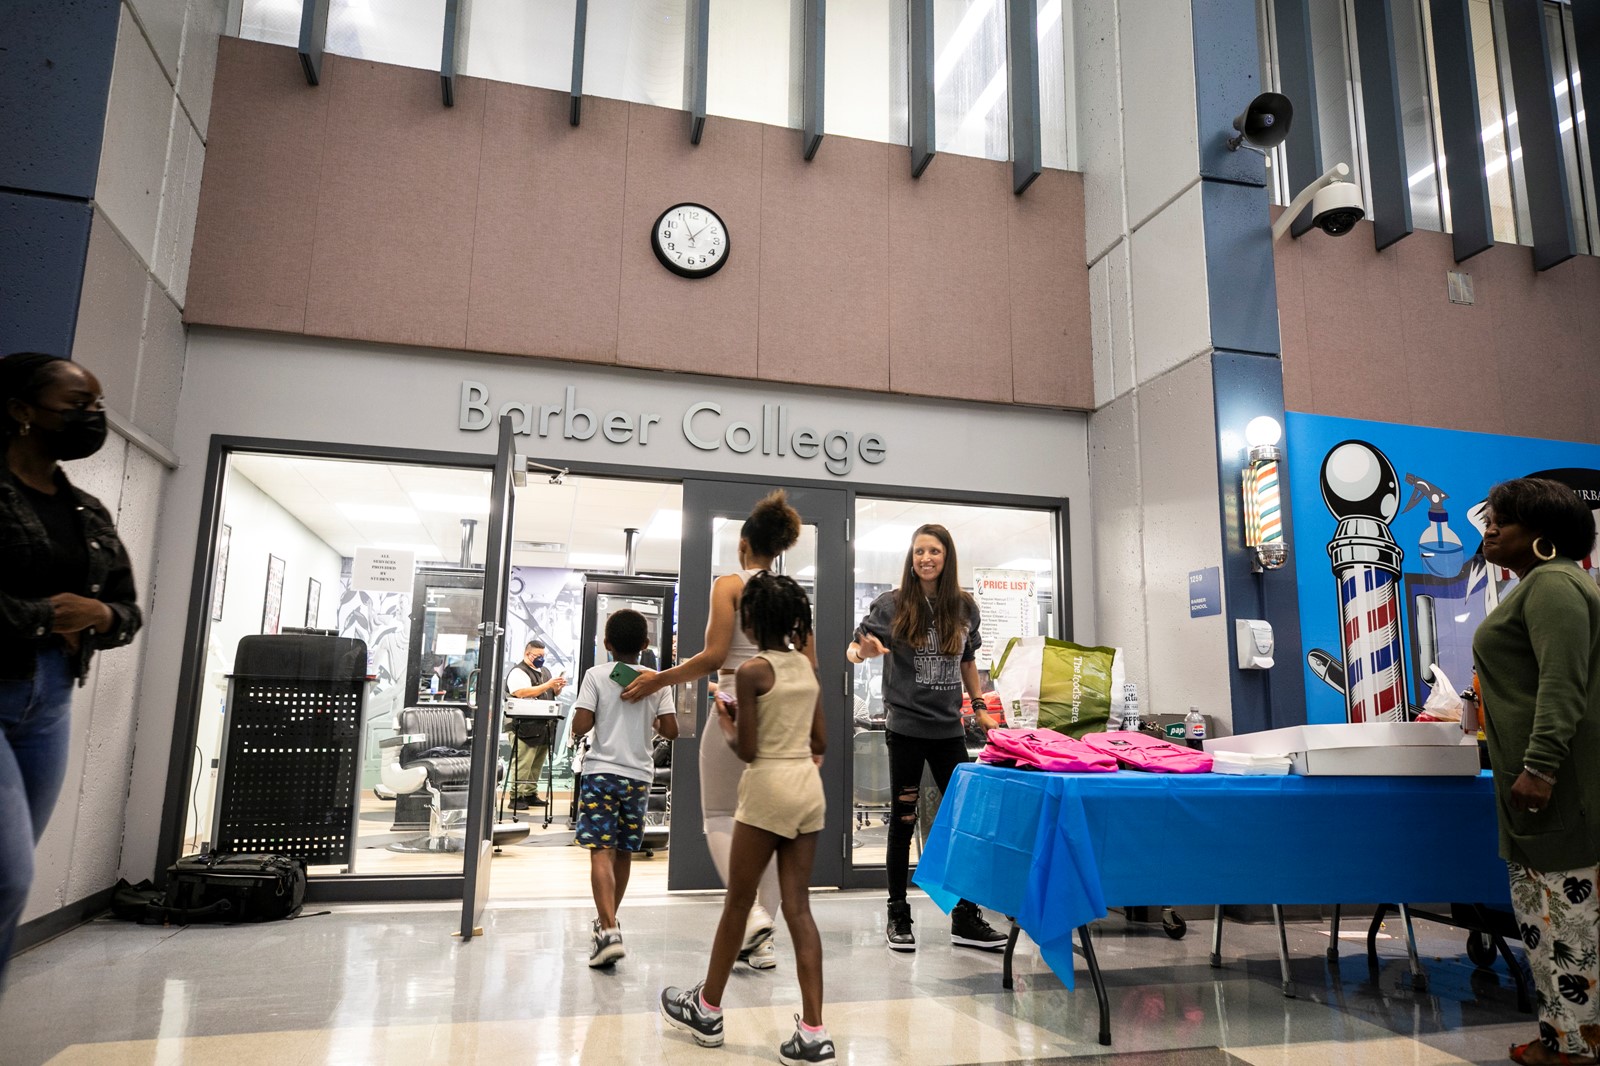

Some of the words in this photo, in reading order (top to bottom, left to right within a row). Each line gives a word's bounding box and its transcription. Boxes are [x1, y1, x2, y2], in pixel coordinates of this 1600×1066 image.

[689, 212, 699, 220] 12
[668, 220, 678, 229] 10
[664, 230, 671, 239] 9
[710, 226, 717, 235] 2
[713, 237, 720, 246] 3
[668, 242, 675, 251] 8
[676, 251, 682, 260] 7
[708, 248, 716, 256] 4
[687, 256, 695, 265] 6
[699, 255, 706, 263] 5
[459, 380, 661, 446] Barber
[682, 400, 887, 476] College
[1190, 574, 1203, 583] 1259
[983, 580, 1008, 590] PRICE
[1010, 581, 1028, 591] LIST
[1073, 656, 1083, 673] The
